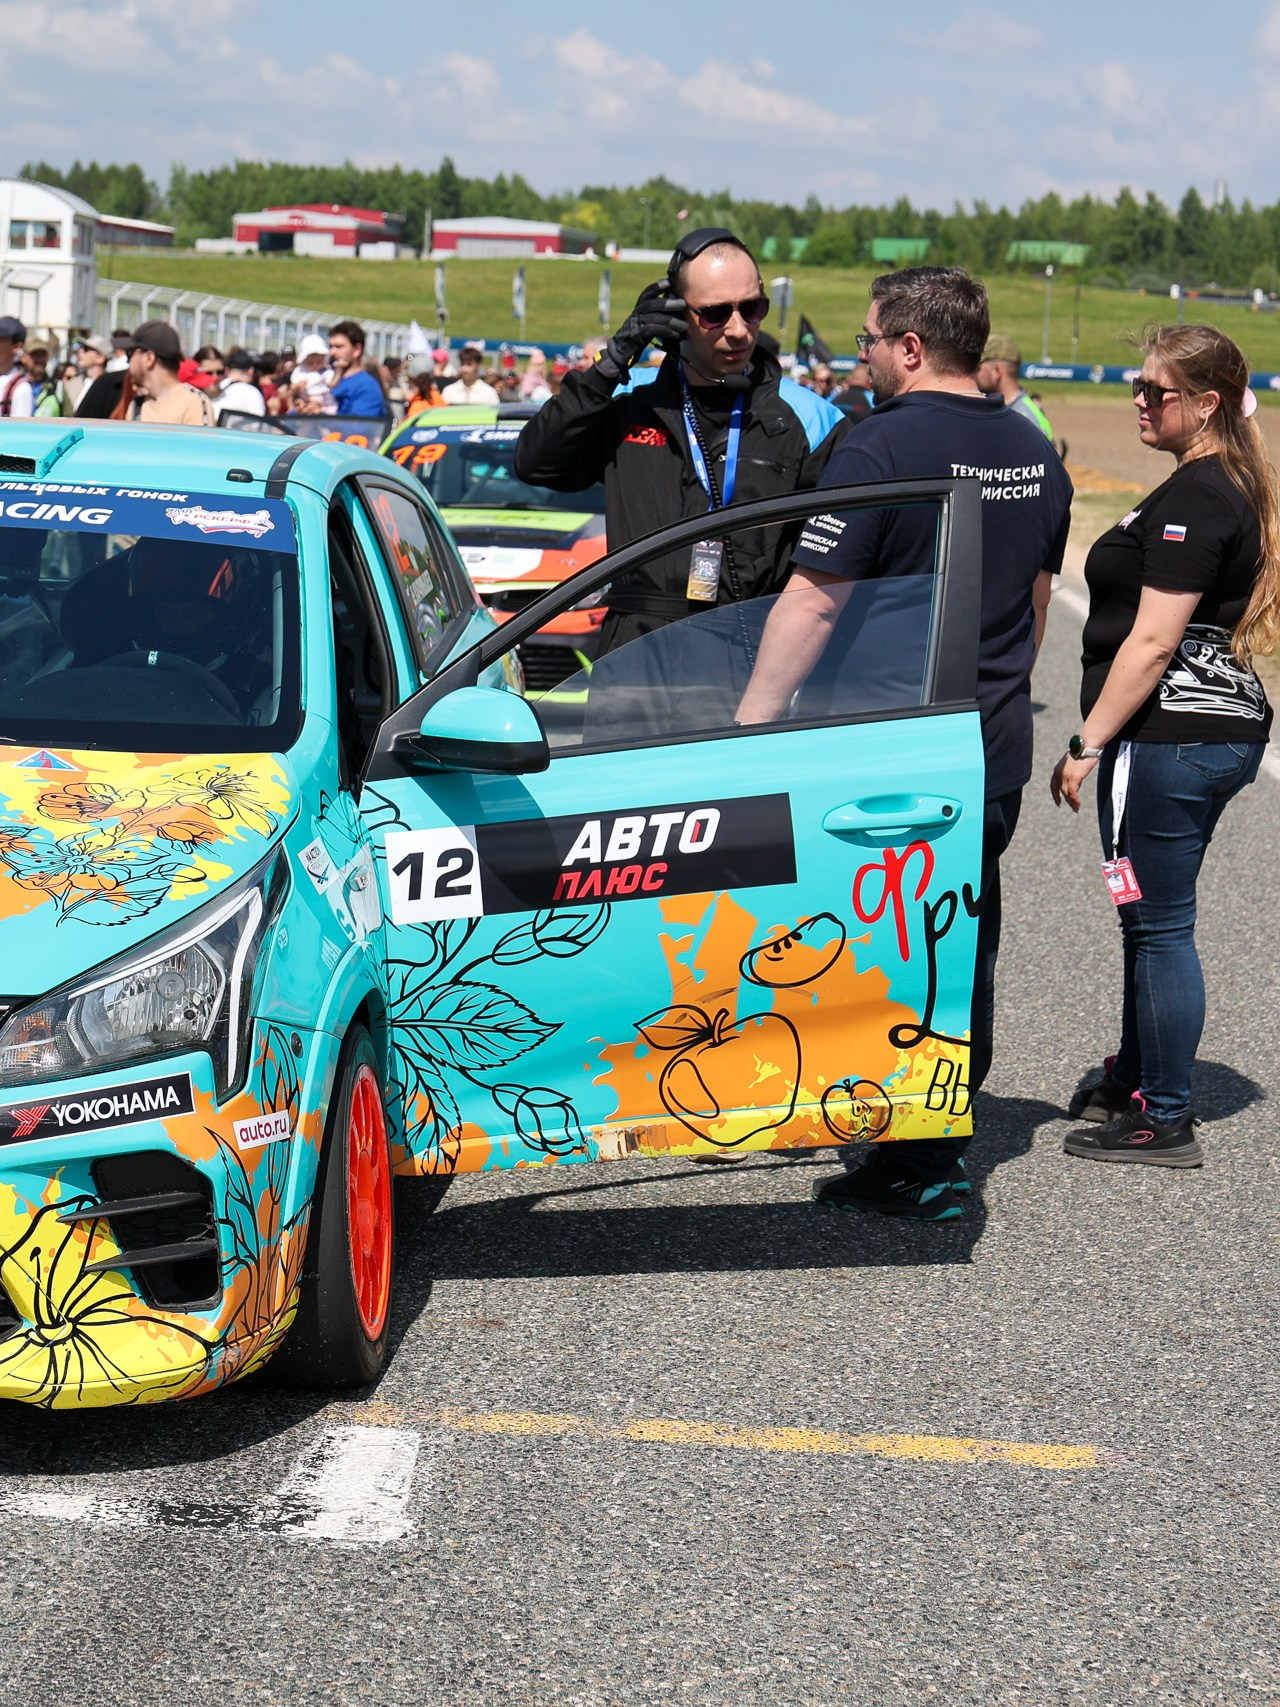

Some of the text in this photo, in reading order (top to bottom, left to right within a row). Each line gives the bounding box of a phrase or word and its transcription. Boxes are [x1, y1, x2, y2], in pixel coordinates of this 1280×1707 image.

[393, 443, 448, 466] 19
[115, 488, 189, 503] гонок
[981, 483, 1041, 501] МИССИЯ
[561, 807, 721, 867] АВТО
[392, 847, 474, 901] 12
[552, 862, 668, 900] ПЛЮС
[51, 1086, 181, 1127] YOKOHAMA
[239, 1118, 287, 1143] auto.ru
